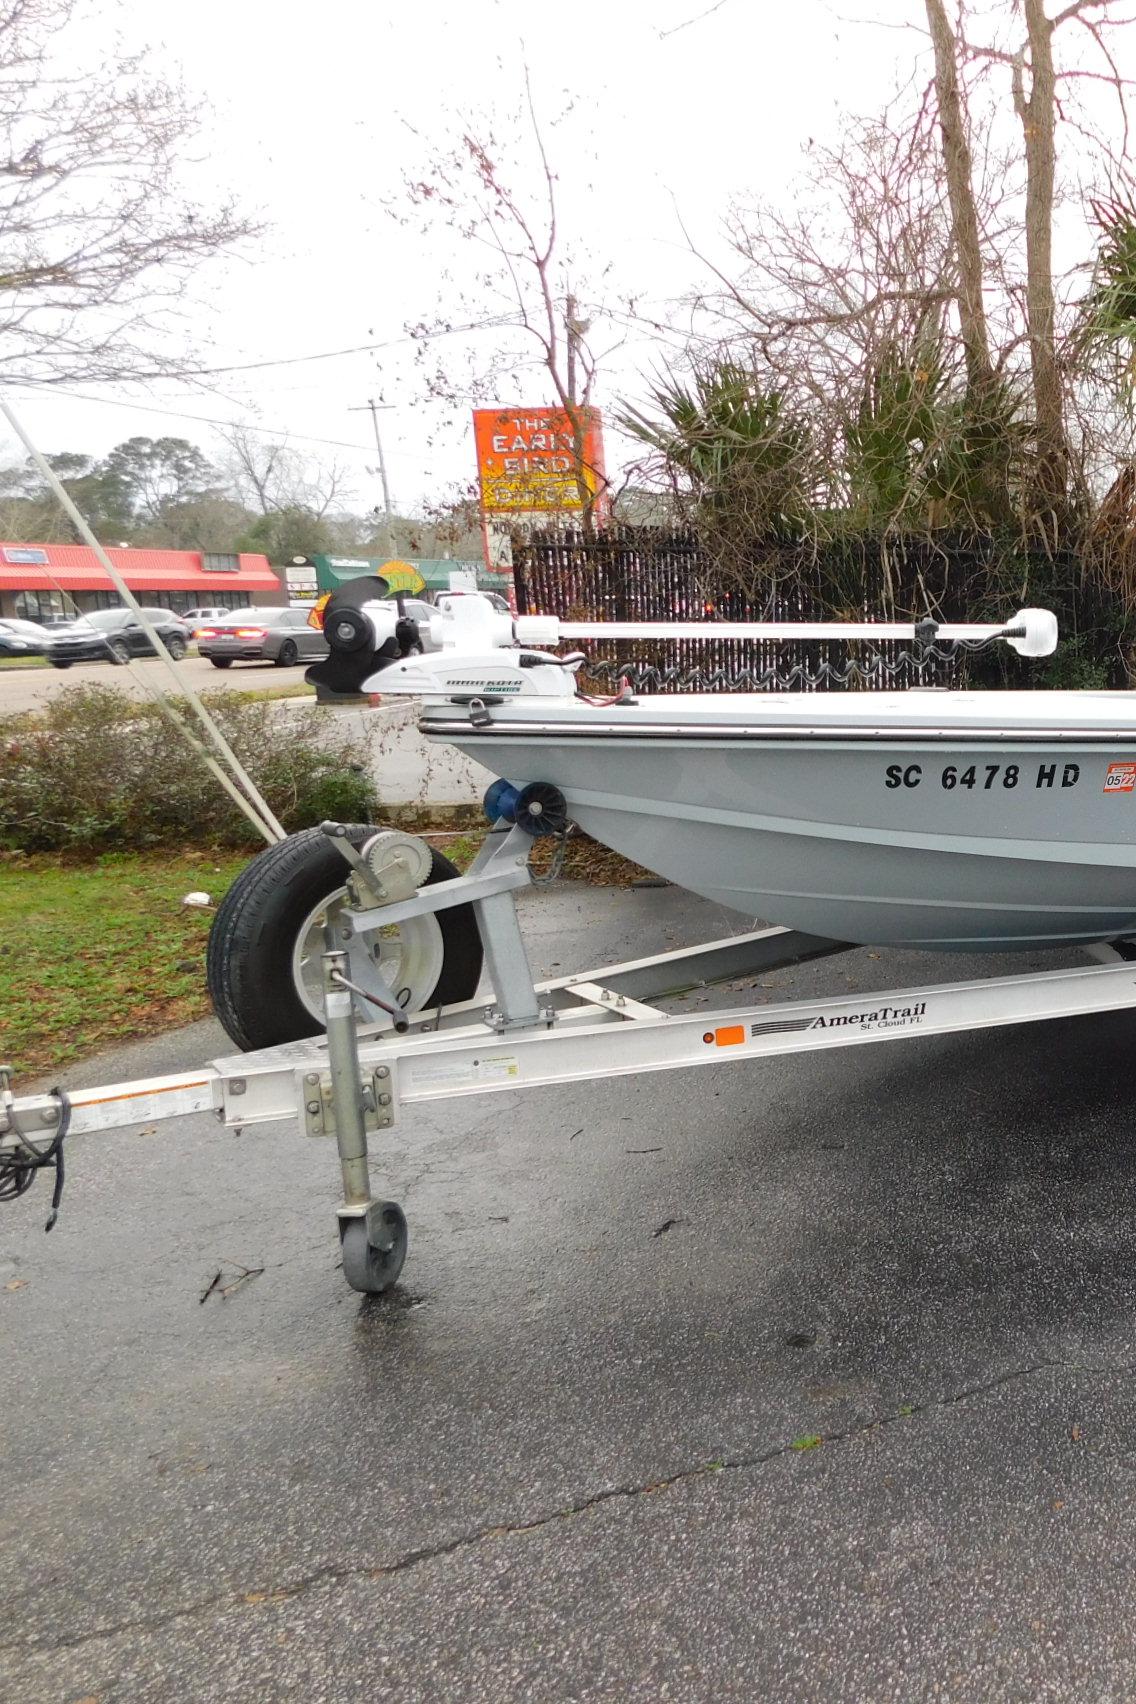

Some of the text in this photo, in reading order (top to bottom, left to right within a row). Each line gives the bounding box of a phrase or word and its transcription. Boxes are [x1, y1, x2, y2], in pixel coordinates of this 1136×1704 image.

[512, 418, 551, 431] THE
[492, 433, 577, 453] EARLY
[503, 456, 571, 475] BIRD
[885, 764, 923, 790] SC
[941, 764, 1020, 790] 6478
[810, 1002, 928, 1030] AmeraTrail
[877, 1017, 906, 1030] Cloud
